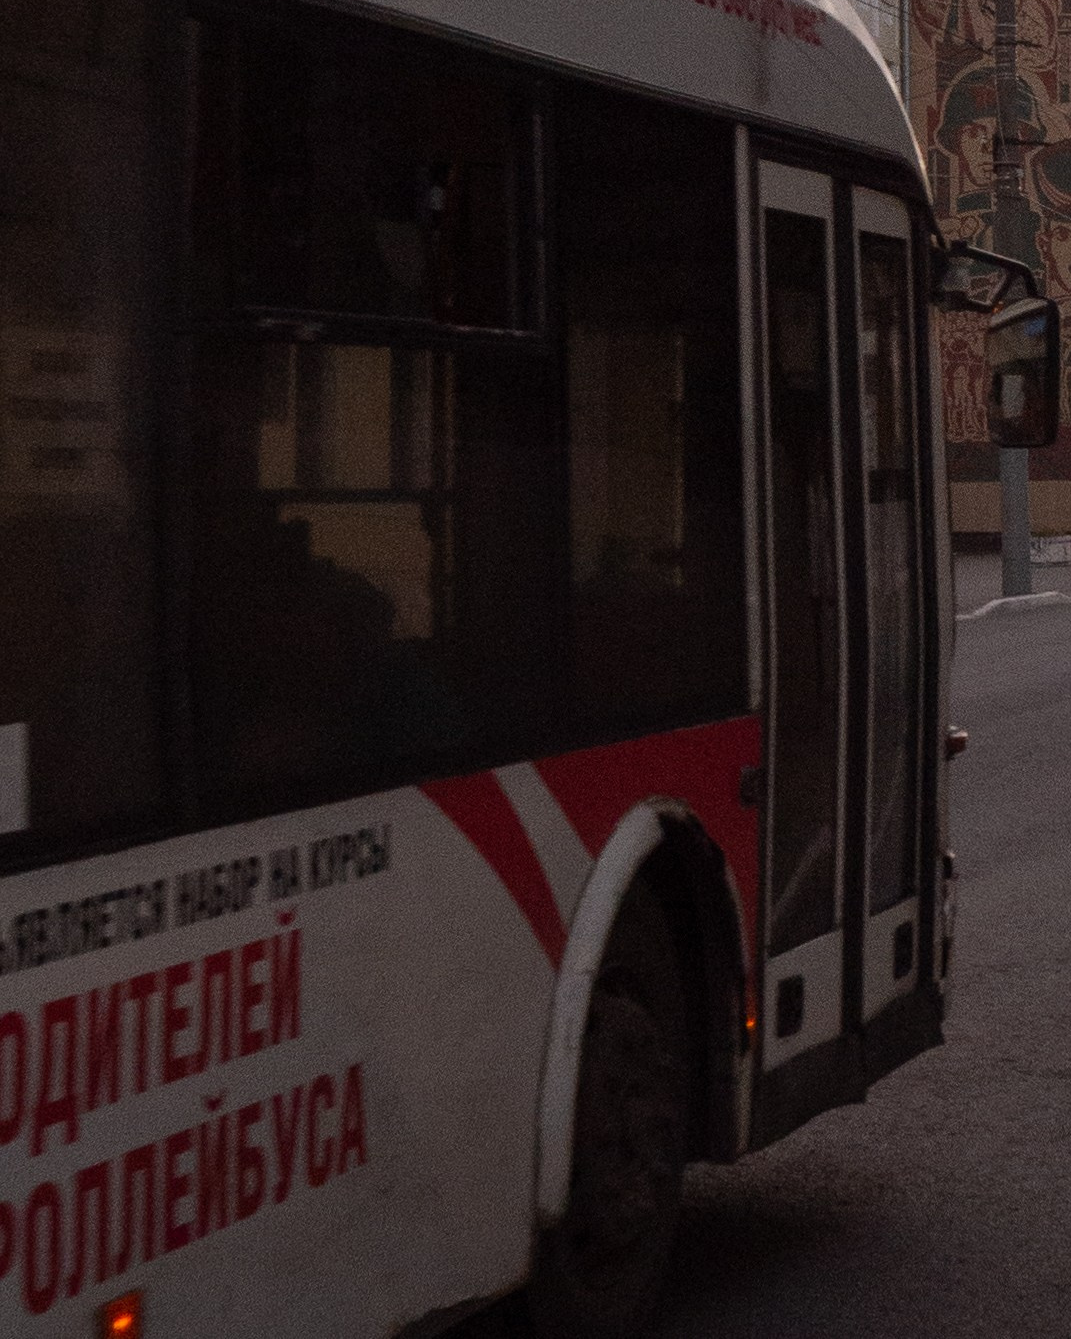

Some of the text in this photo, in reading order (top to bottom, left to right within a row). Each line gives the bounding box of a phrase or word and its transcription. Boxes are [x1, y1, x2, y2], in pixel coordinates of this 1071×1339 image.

[174, 856, 260, 928] НАБОР
[269, 846, 301, 901] НА
[308, 823, 392, 891] КУРСЫ
